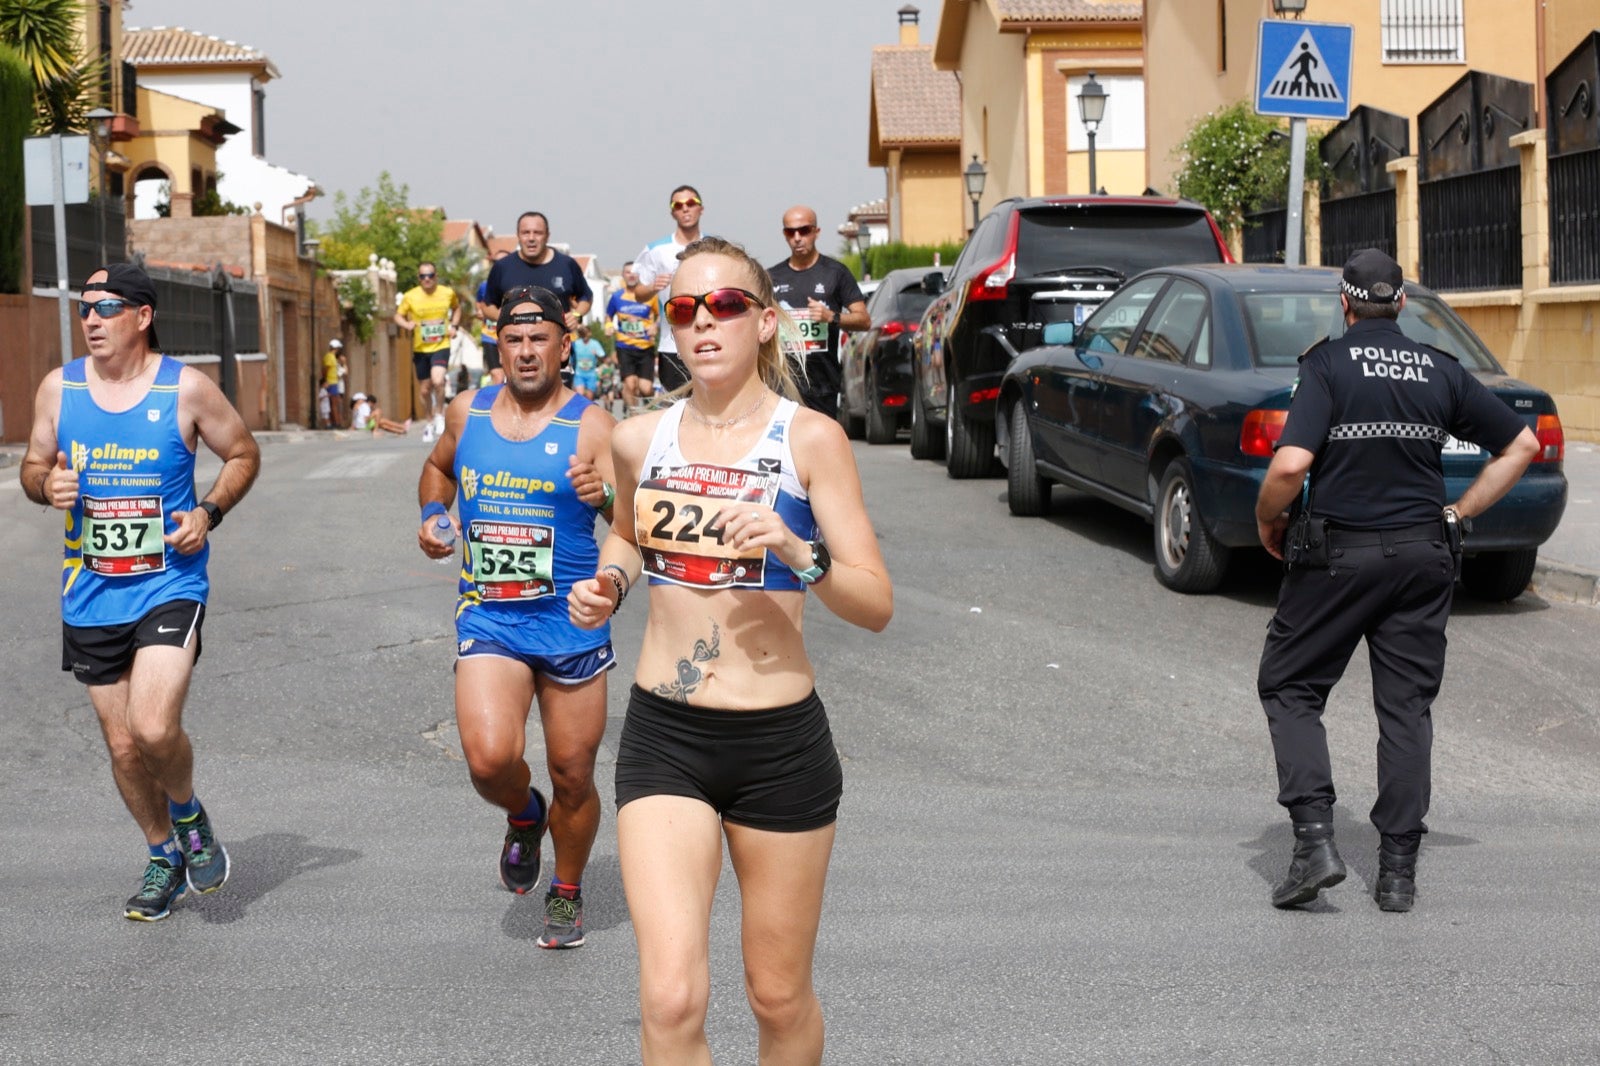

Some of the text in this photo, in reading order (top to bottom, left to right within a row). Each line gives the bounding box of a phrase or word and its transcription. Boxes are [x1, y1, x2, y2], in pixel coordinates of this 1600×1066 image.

[1349, 347, 1435, 368] POLICIA
[1362, 362, 1429, 383] LOCAL
[91, 443, 159, 464] olimpo
[90, 461, 133, 471] deportes
[87, 477, 162, 487] TRAIL & RUNNING
[482, 471, 556, 494] olimpo
[694, 466, 727, 485] PREMIO
[728, 472, 741, 486] DE
[480, 487, 525, 499] deportes
[666, 479, 702, 493] DIPUTACIÓN
[107, 500, 129, 510] PREMIO
[129, 500, 138, 510] DE
[478, 503, 555, 519] TRAIL & RUNNING
[92, 523, 149, 551] 537
[483, 524, 498, 534] GRAN
[498, 525, 519, 537] PREMIO
[520, 527, 528, 537] DE
[481, 547, 537, 575] 525
